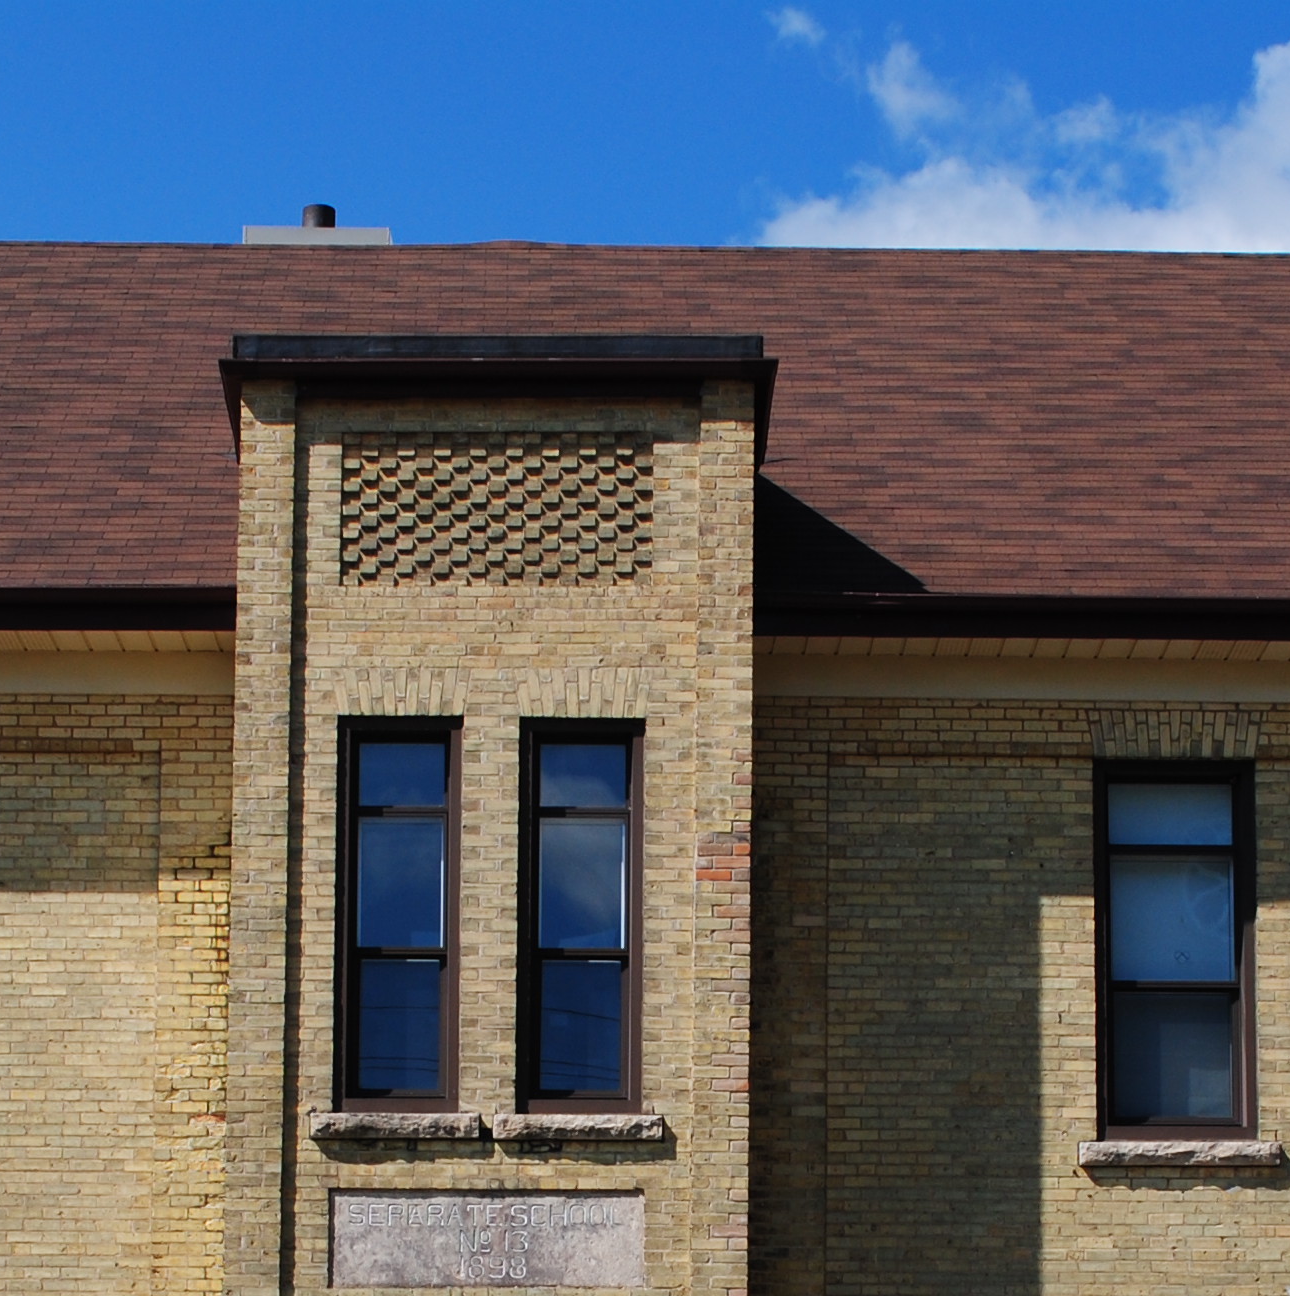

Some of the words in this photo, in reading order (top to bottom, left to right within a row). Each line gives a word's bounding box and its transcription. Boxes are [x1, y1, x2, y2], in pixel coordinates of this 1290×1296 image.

[348, 1203, 504, 1227] SEPARATE
[510, 1203, 625, 1227] SCHOOL
[504, 1230, 529, 1253] 13
[459, 1255, 528, 1279] 1898
